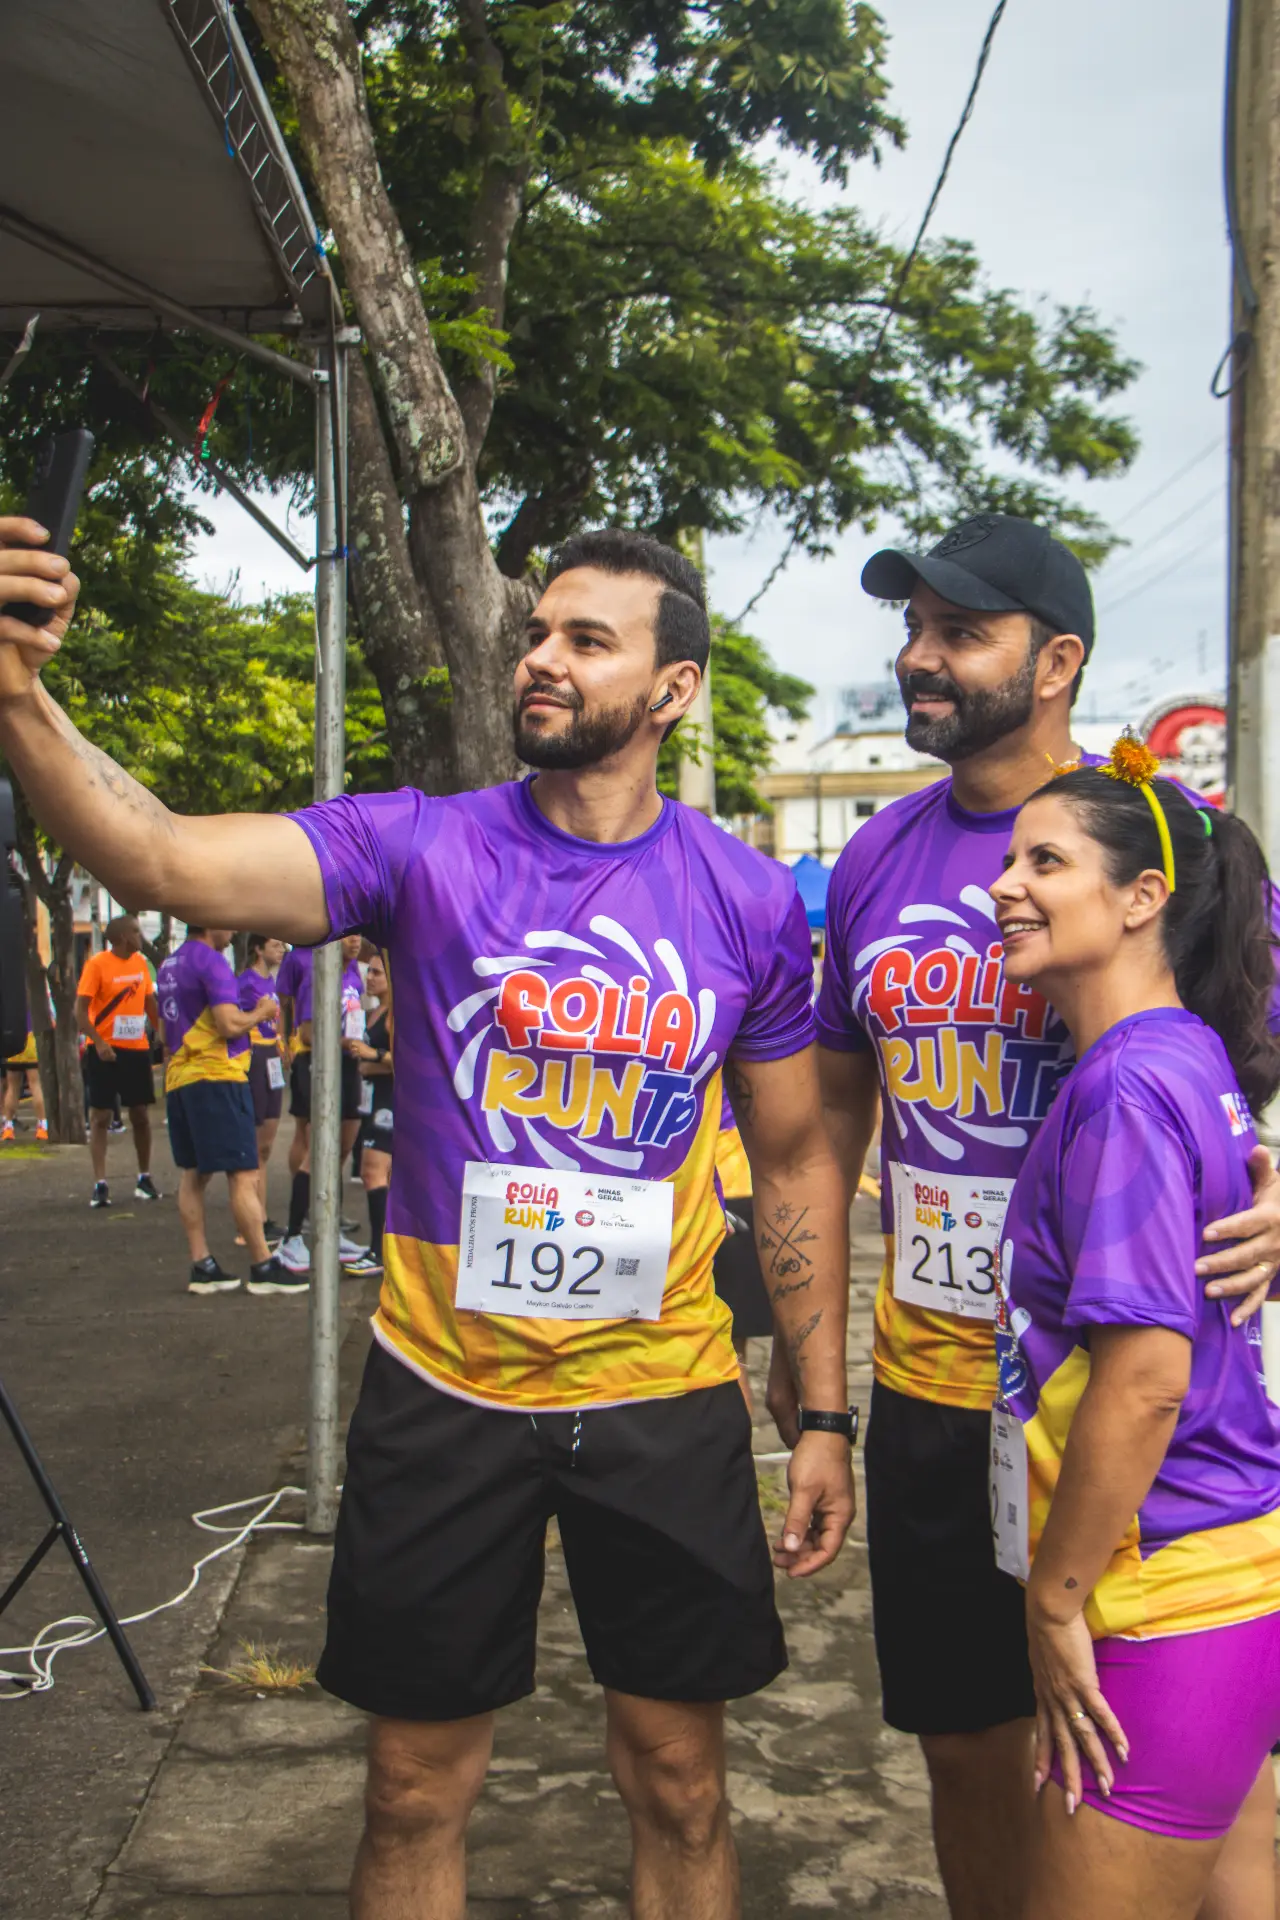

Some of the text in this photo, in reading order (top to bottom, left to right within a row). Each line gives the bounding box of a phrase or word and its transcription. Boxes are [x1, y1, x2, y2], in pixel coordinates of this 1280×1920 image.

[879, 1027, 1004, 1118] RUN
[481, 1048, 646, 1139] RUN
[597, 1194, 624, 1202] GERAIS
[598, 1188, 621, 1196] MINAS
[982, 1195, 1008, 1203] GERAIS
[504, 1206, 547, 1230] RUN
[915, 1207, 942, 1230] RUN
[491, 1238, 604, 1295] 192
[911, 1235, 995, 1295] 213
